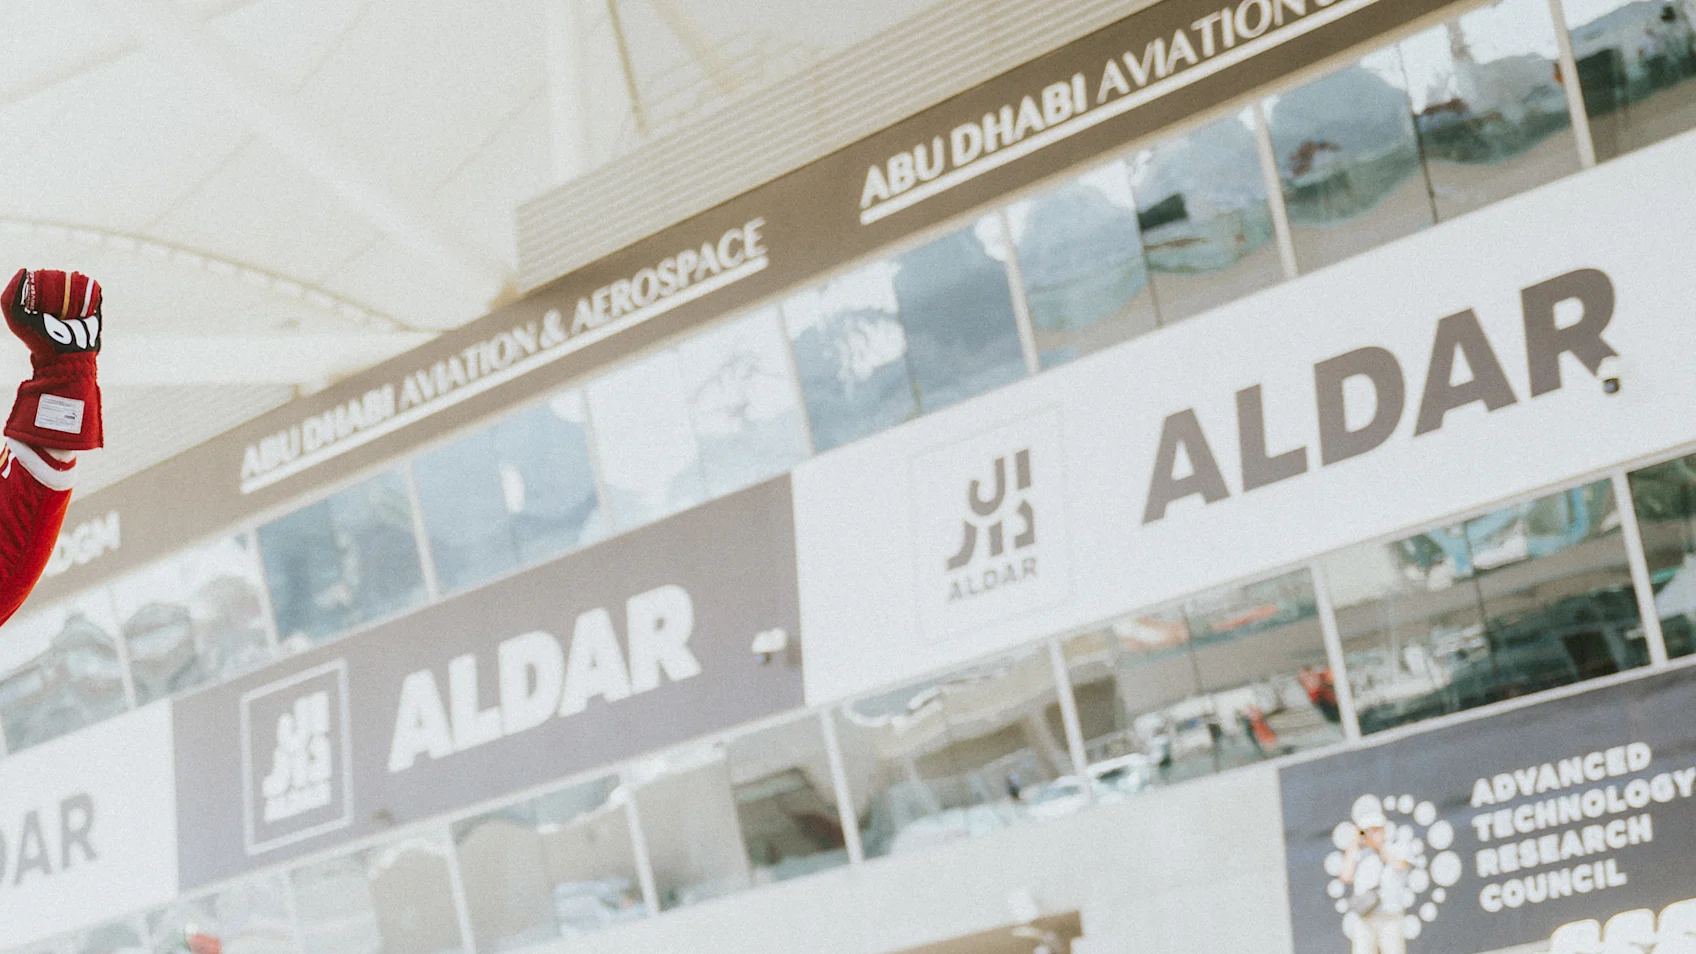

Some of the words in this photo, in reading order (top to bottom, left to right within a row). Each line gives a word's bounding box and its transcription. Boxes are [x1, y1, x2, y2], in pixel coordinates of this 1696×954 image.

[860, 136, 945, 209] ABU
[950, 73, 1088, 168] DHABI
[240, 424, 301, 478] ABU
[303, 383, 396, 450] DHABI
[399, 321, 538, 411] AVIATION
[540, 308, 568, 349] &
[570, 216, 768, 335] AEROSPACE
[1142, 267, 1620, 525] ALDAR
[948, 557, 1037, 601] ALDAR
[388, 584, 701, 772] ALDAR
[1470, 741, 1652, 808] ADVANCED
[1471, 767, 1696, 841] TECHNOLOGY
[1476, 814, 1653, 878] RESEARCH
[1479, 859, 1627, 913] COUNCIL
